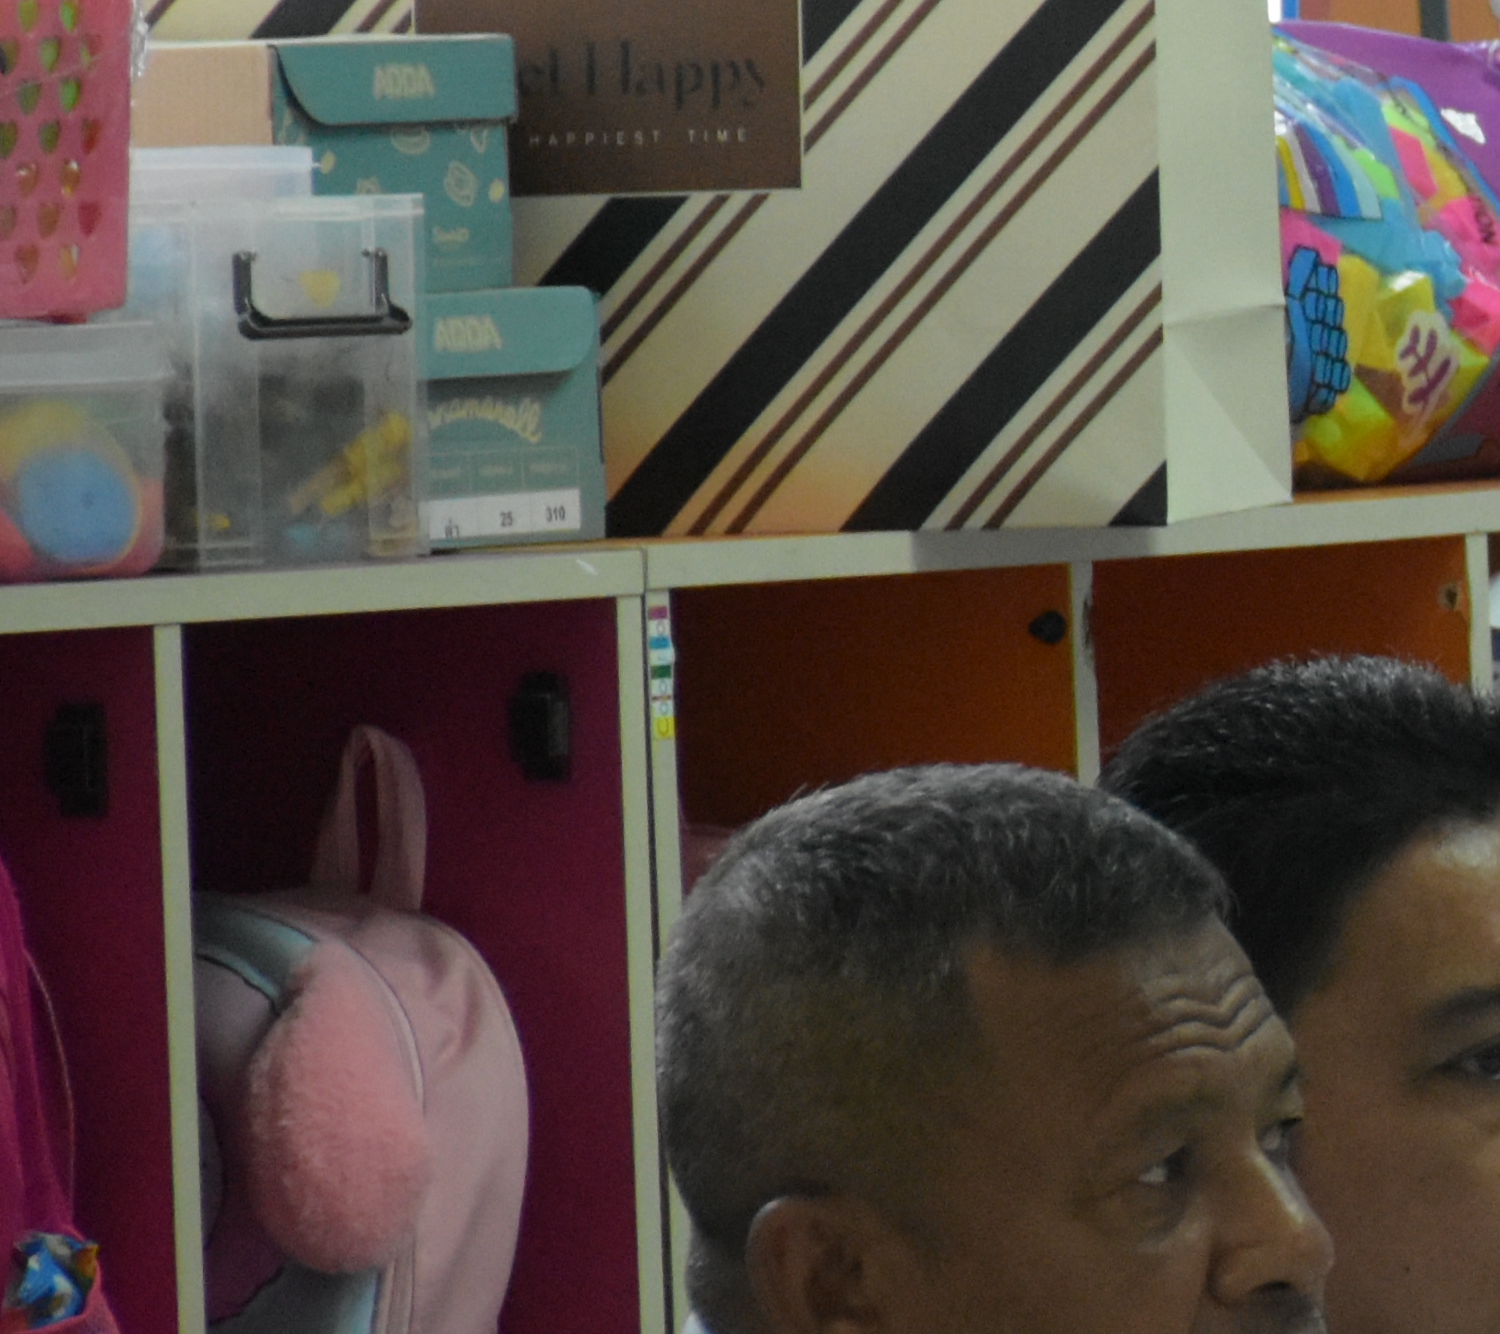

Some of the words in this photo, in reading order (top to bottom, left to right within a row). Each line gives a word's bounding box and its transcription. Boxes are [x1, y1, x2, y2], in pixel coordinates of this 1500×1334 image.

[586, 40, 766, 111] Happy
[529, 129, 662, 147] HAPPIEST
[688, 128, 747, 144] TIME
[501, 511, 513, 528] 25
